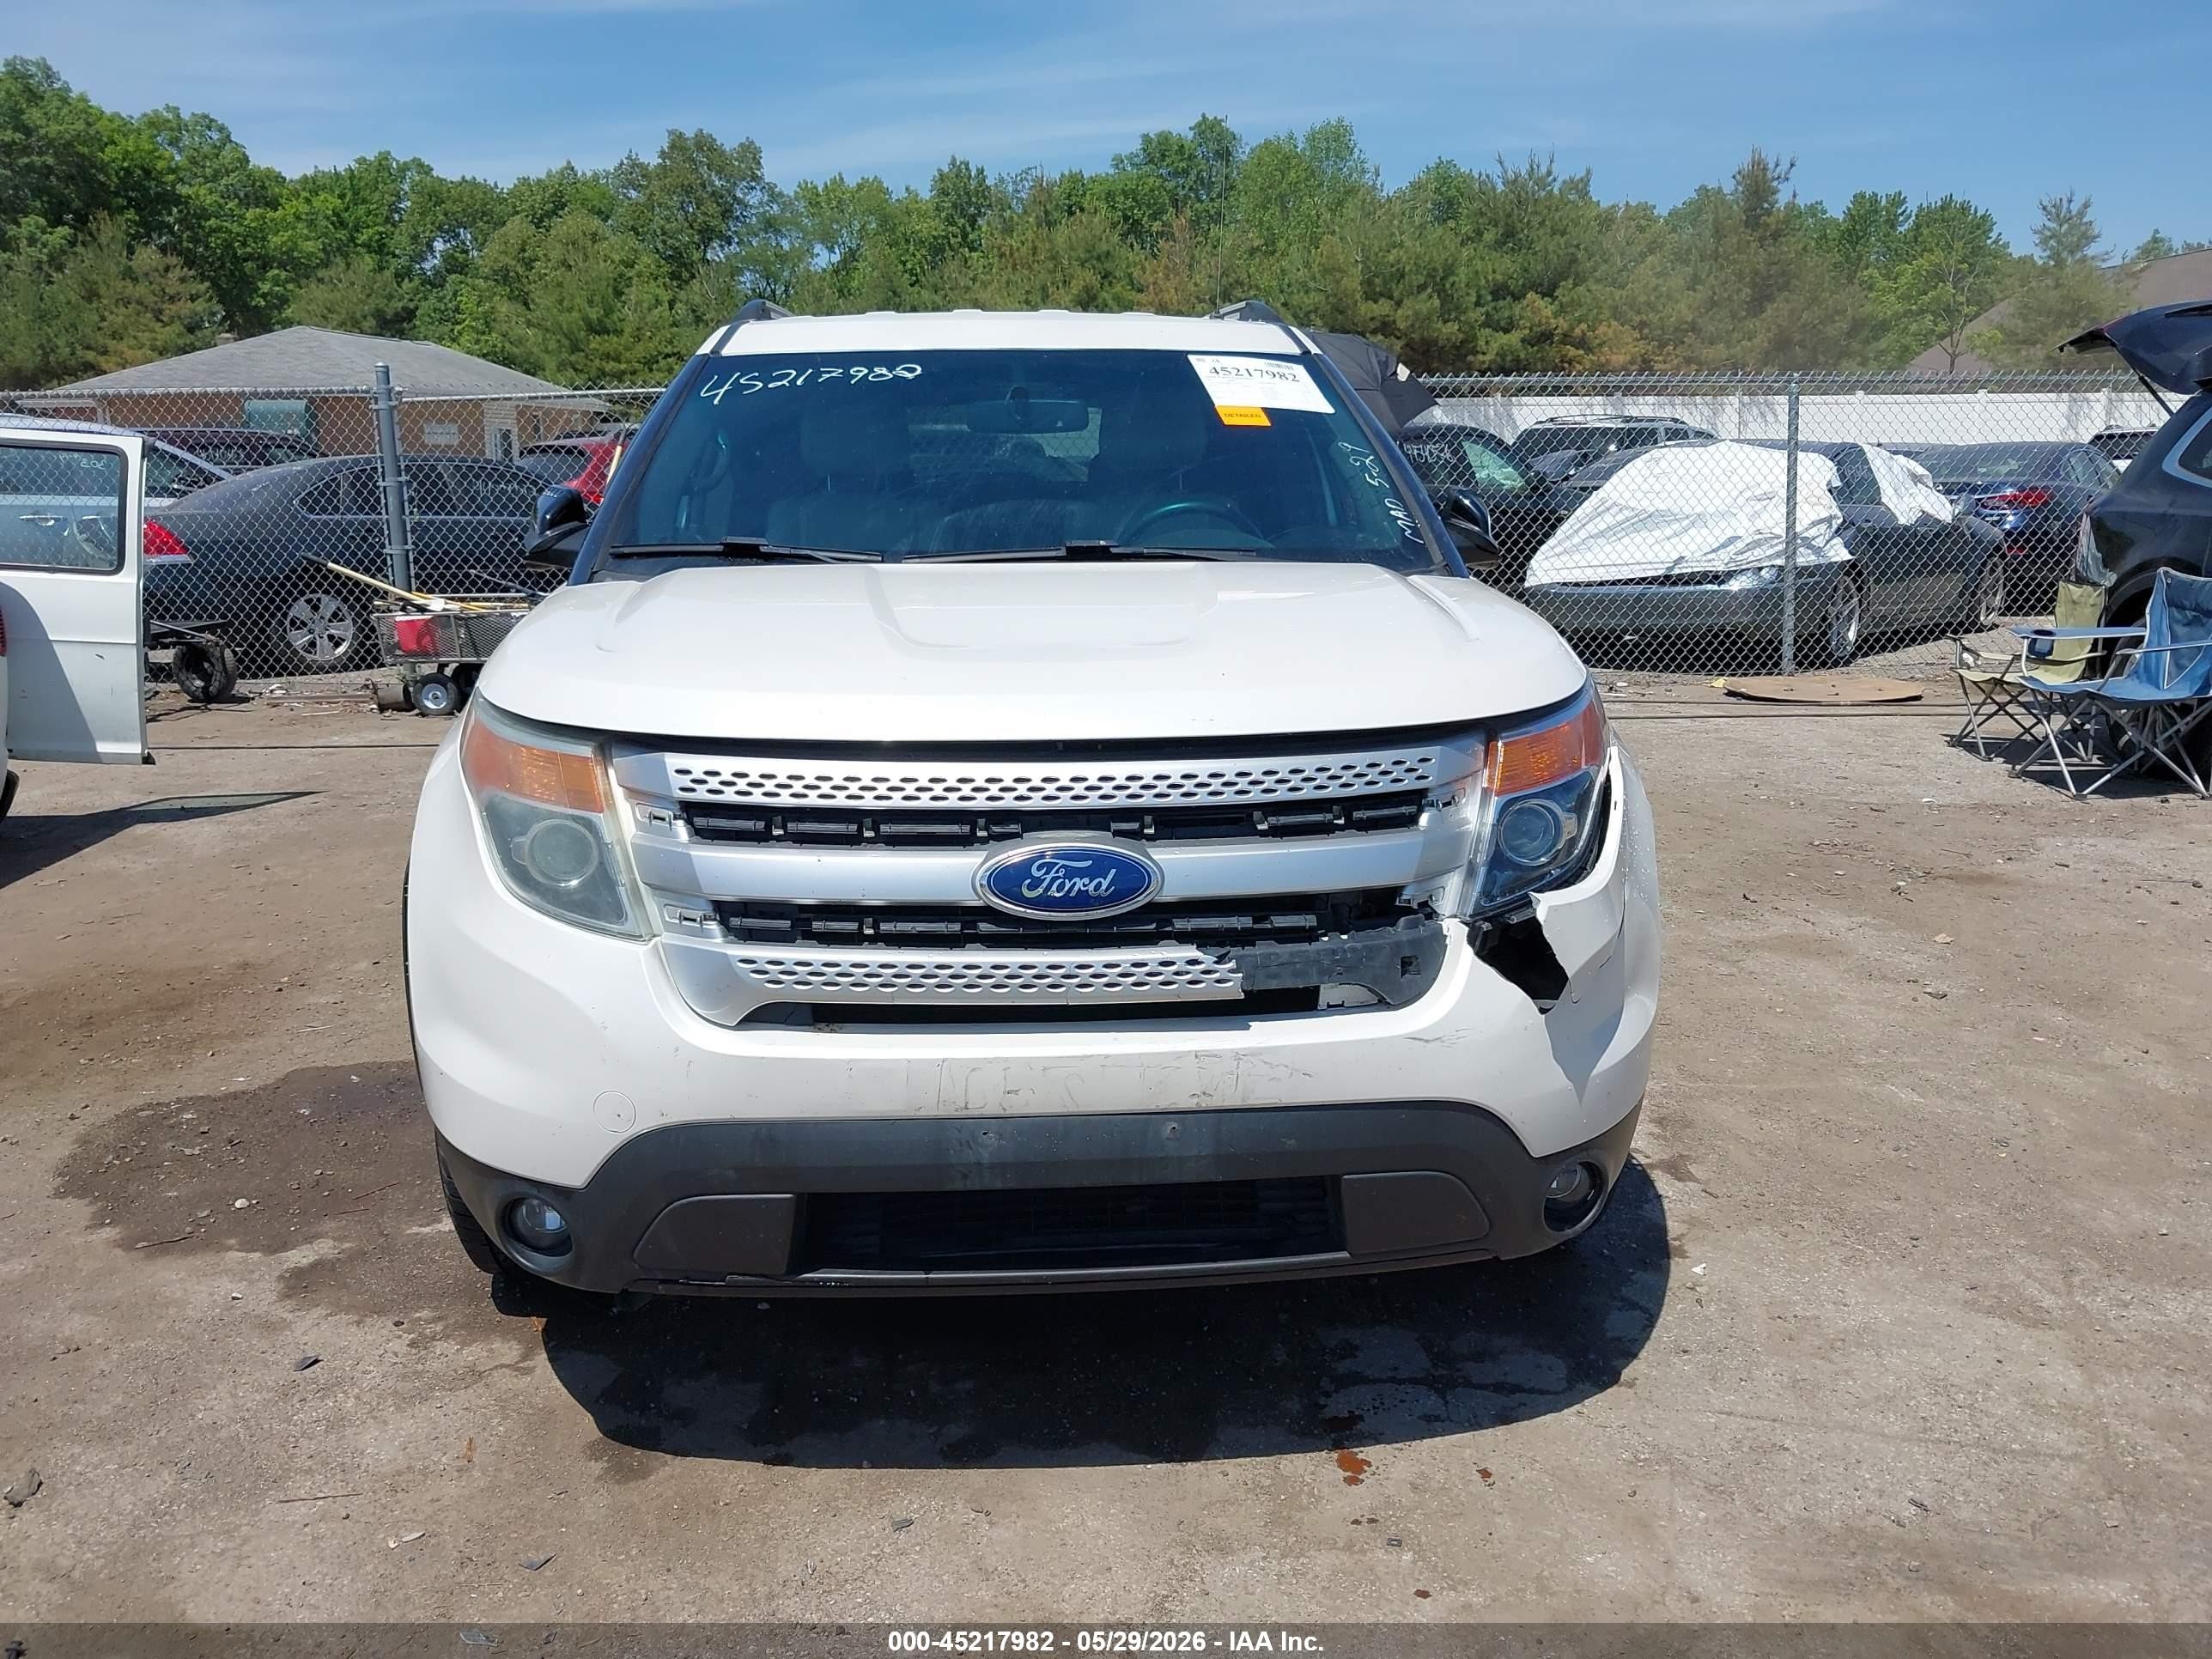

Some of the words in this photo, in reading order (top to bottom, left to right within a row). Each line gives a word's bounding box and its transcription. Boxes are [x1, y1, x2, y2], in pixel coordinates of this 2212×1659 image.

[700, 364, 922, 405] 45217982
[1209, 365, 1300, 383] 45217982
[1022, 859, 1116, 898] Ford
